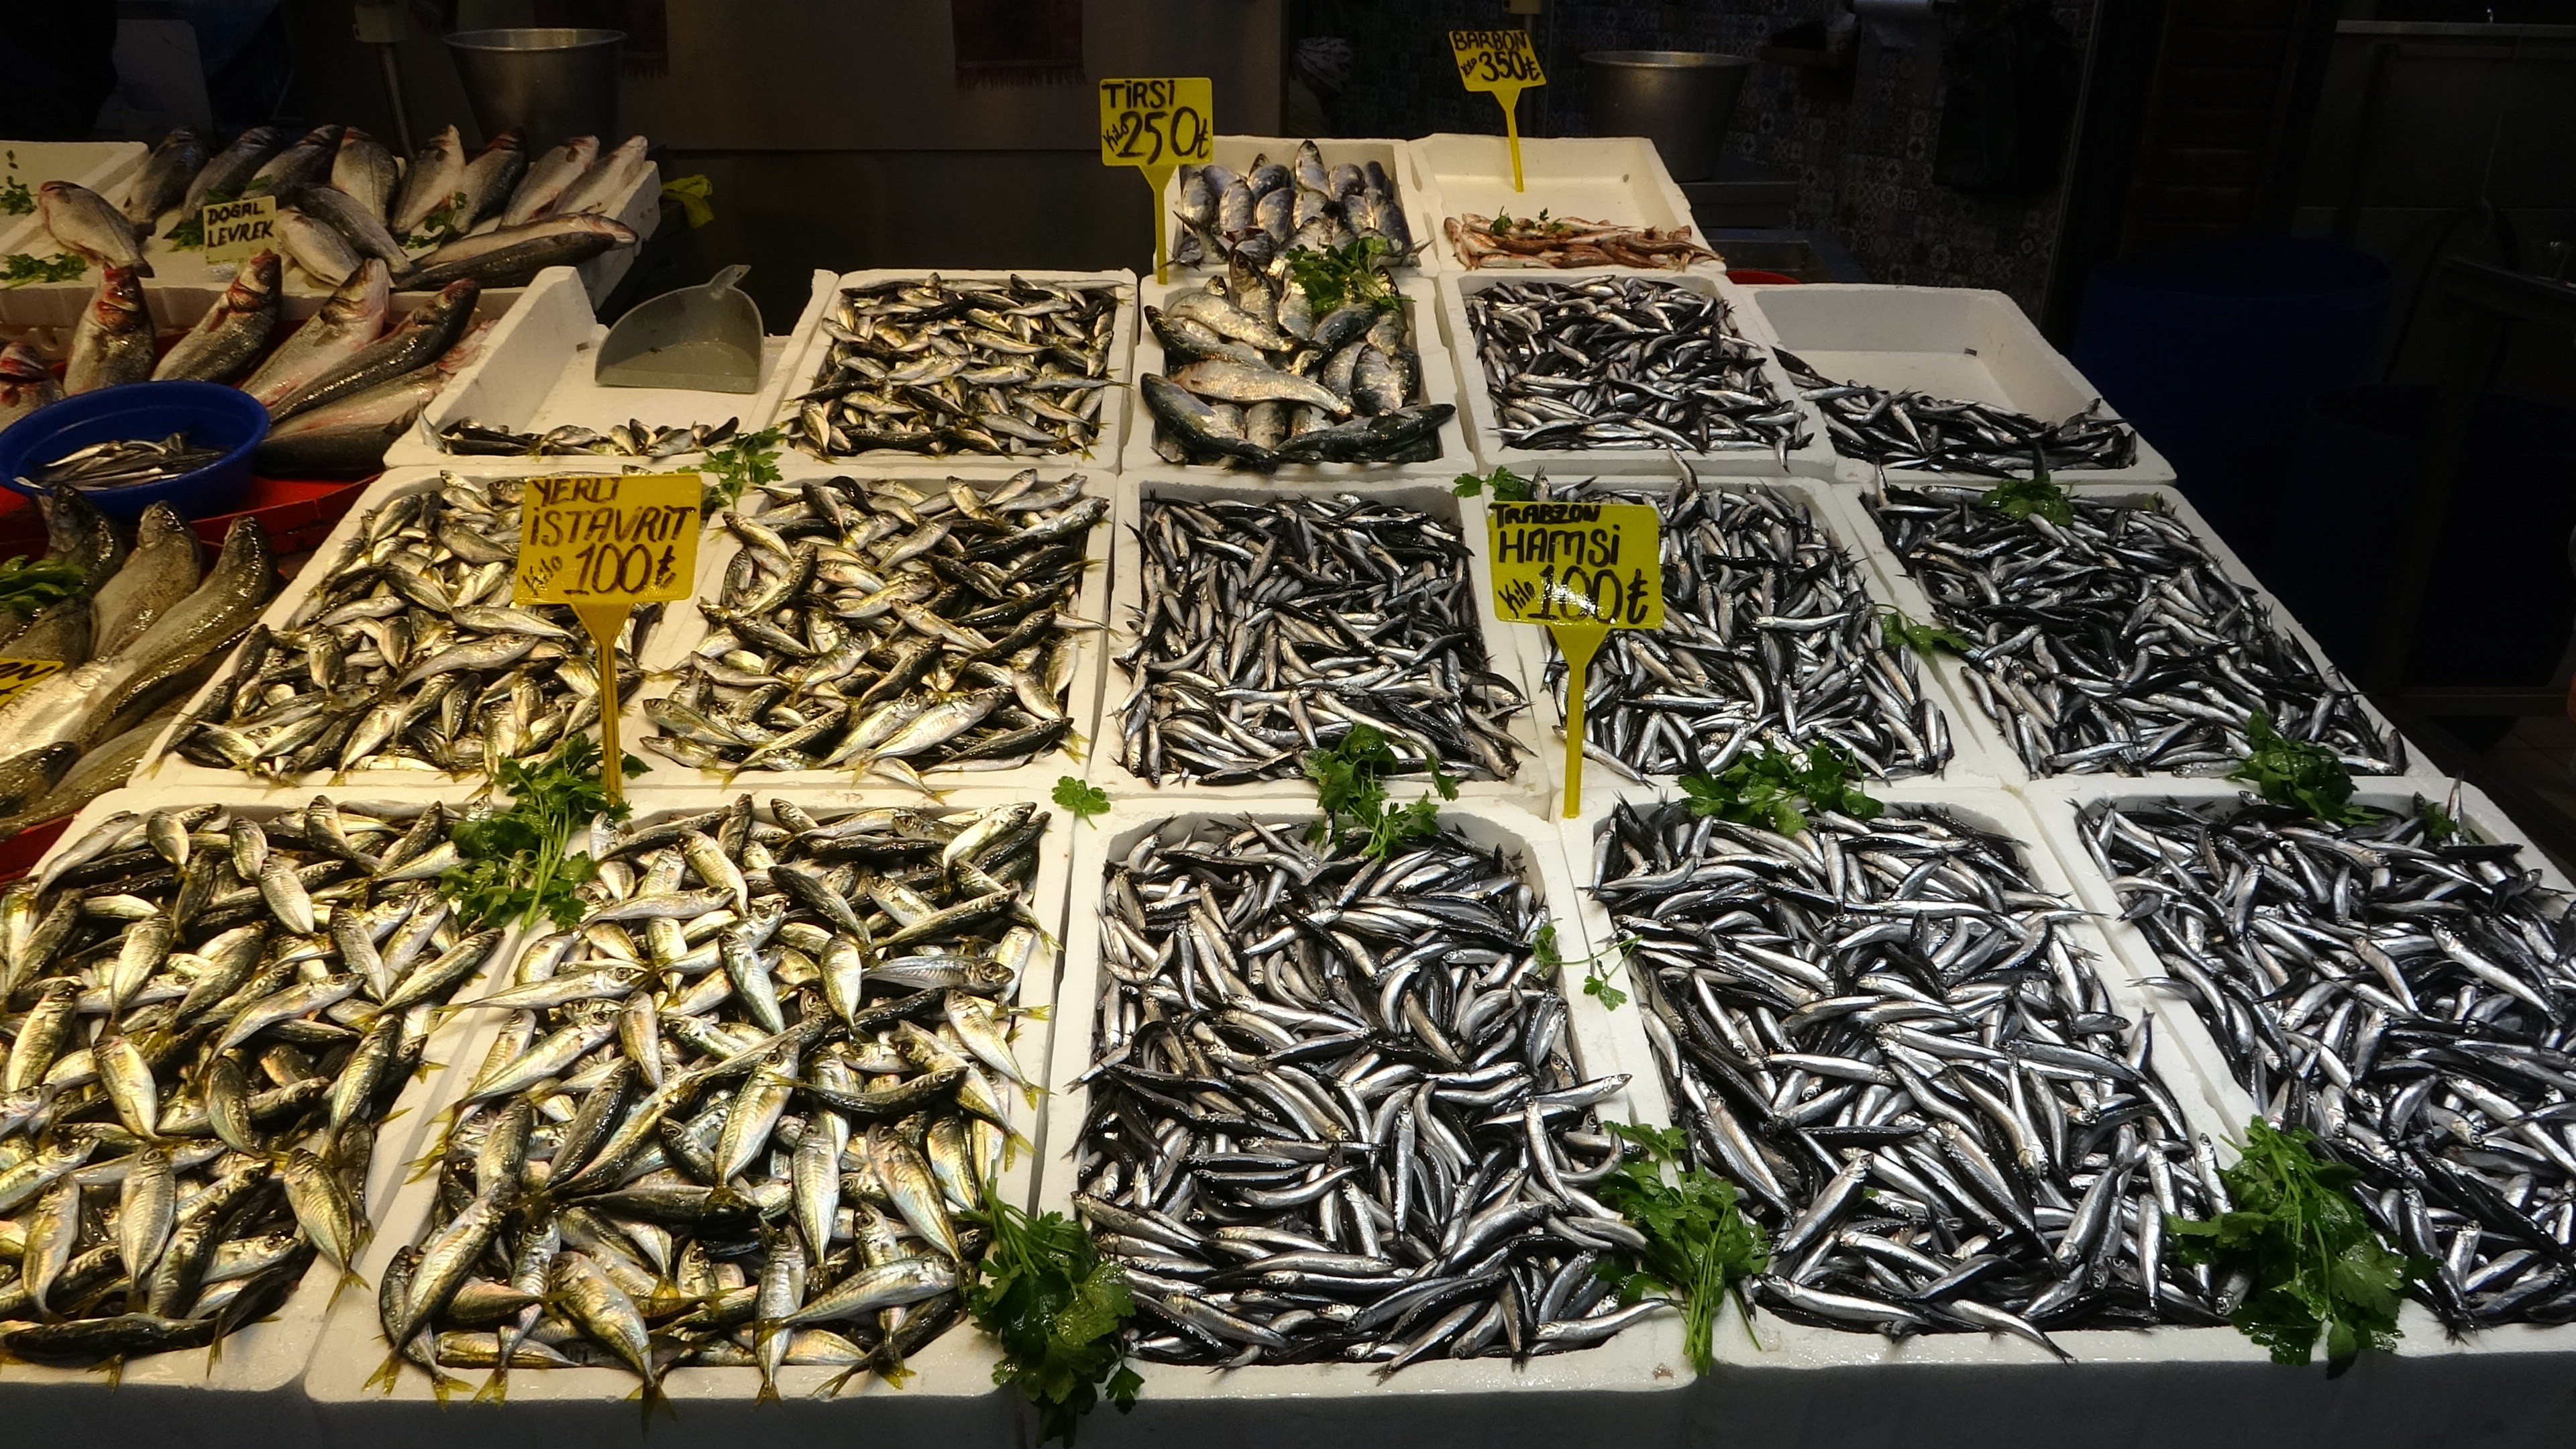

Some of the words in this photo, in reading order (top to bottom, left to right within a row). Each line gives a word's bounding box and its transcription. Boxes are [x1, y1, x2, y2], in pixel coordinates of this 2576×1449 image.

[1452, 32, 1527, 50] BARBON
[207, 219, 274, 248] LEVREK
[1489, 502, 1601, 529] TRABZON
[1497, 578, 1536, 619] Kilo
